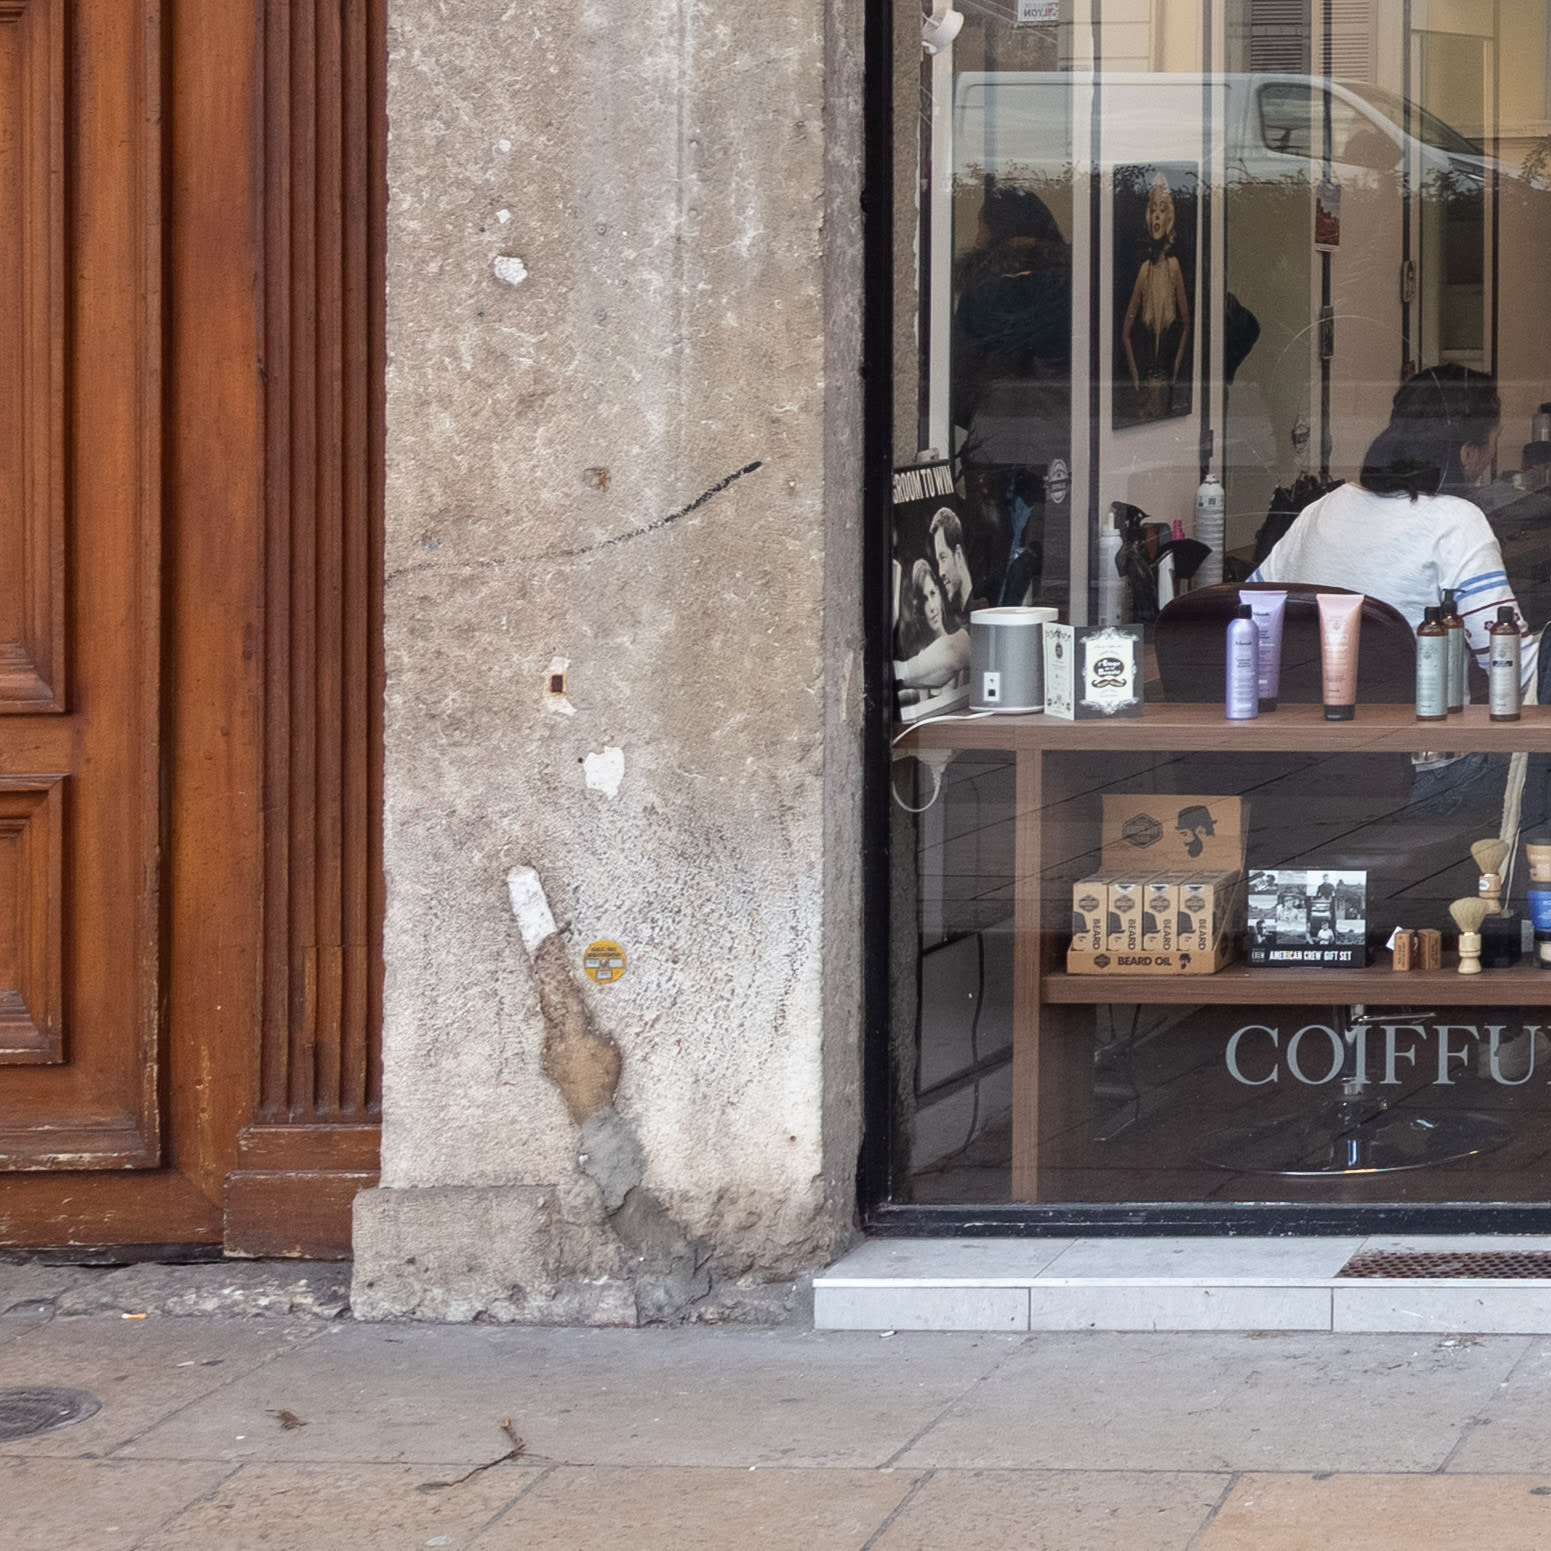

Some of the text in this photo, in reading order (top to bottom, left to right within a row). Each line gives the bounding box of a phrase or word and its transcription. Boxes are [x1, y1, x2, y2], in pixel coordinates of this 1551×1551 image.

[1093, 918, 1102, 951] BEARD
[1128, 918, 1136, 951] BEARD
[1163, 919, 1172, 951] BEARD
[1198, 919, 1207, 951] BEARD
[1118, 956, 1153, 966] BEARD
[1339, 950, 1353, 960] SET
